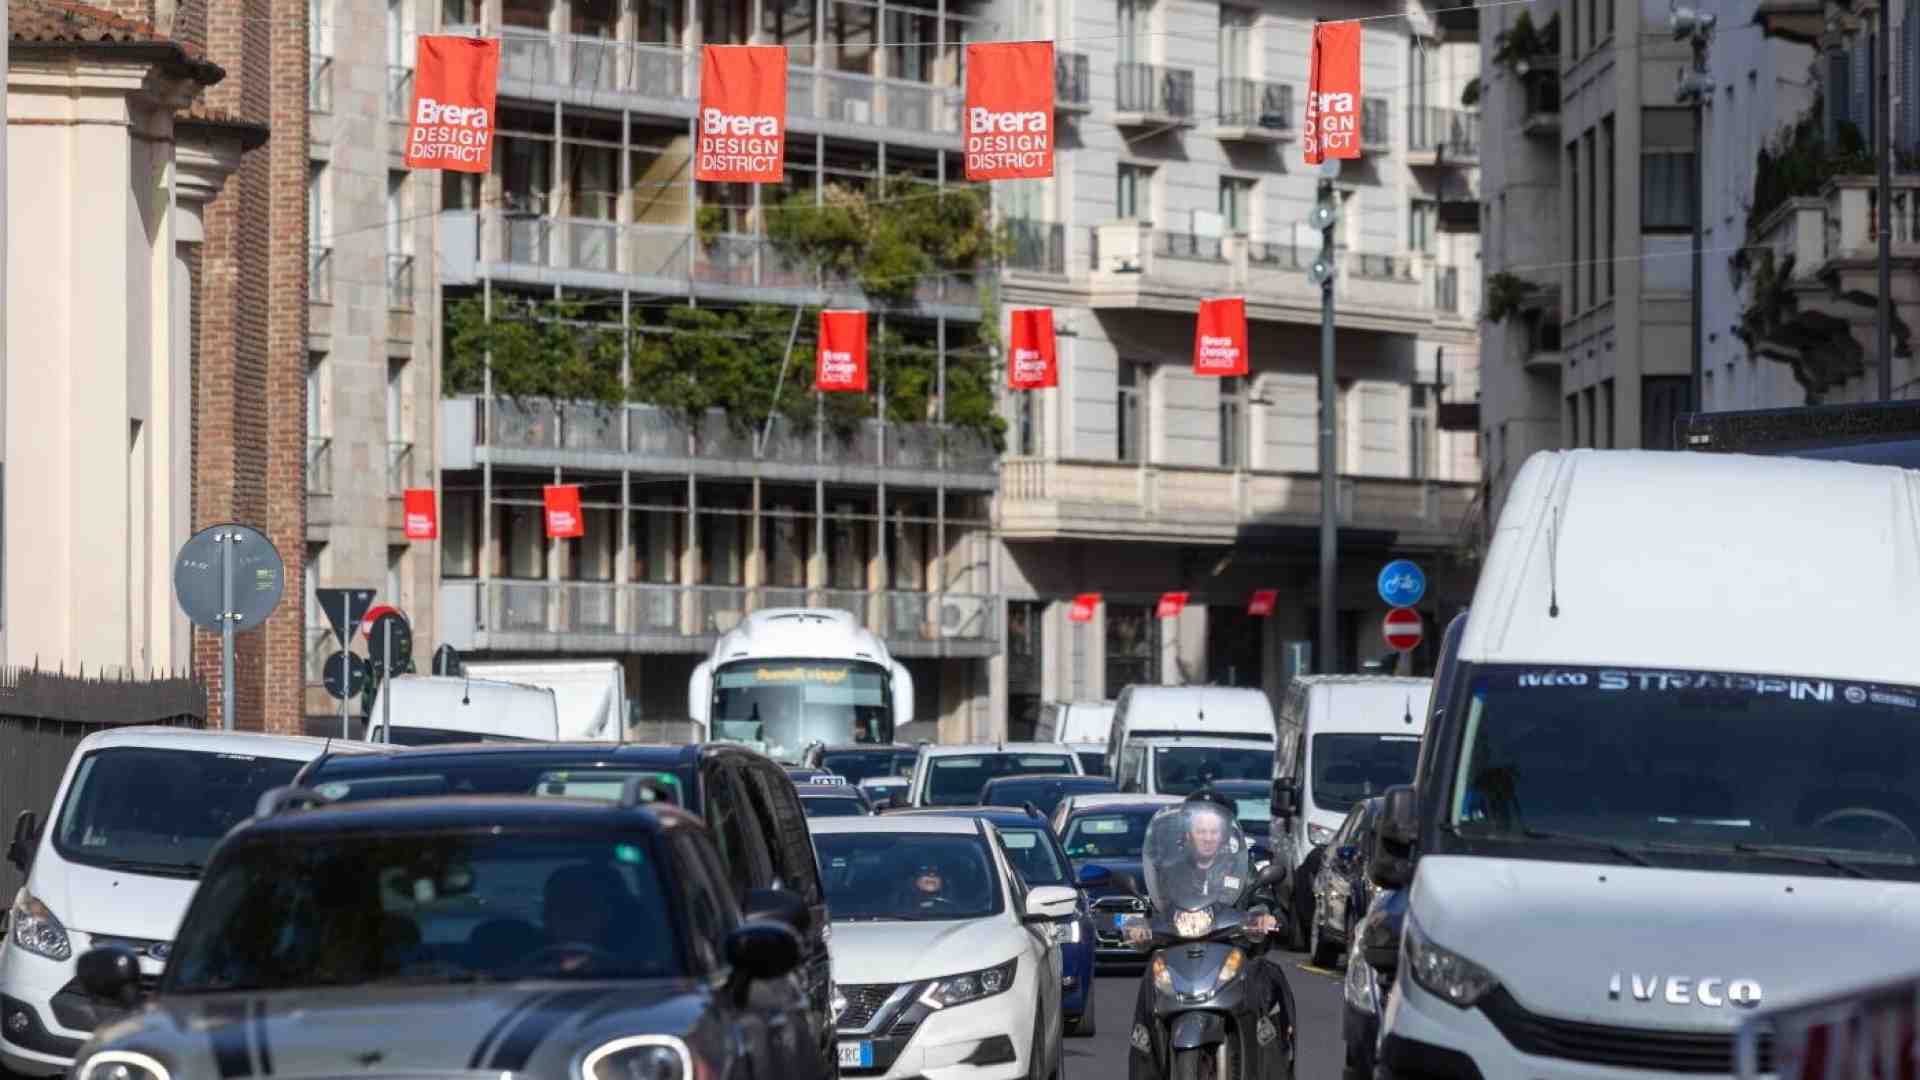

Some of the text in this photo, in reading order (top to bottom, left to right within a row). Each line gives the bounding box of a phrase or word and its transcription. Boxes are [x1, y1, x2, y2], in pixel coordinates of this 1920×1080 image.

[416, 98, 488, 128] Brera
[704, 108, 778, 136] Brera
[970, 106, 1047, 133] Brera
[413, 126, 488, 145] DESIGN
[969, 135, 1047, 152] DESIGN
[410, 143, 487, 163] DISTRICT
[703, 137, 778, 154] DESIGN
[702, 154, 777, 172] DISTRICT
[968, 151, 1046, 170] DISTRICT
[1518, 672, 1589, 688] IVECO
[1608, 972, 1763, 1010] IVECO
